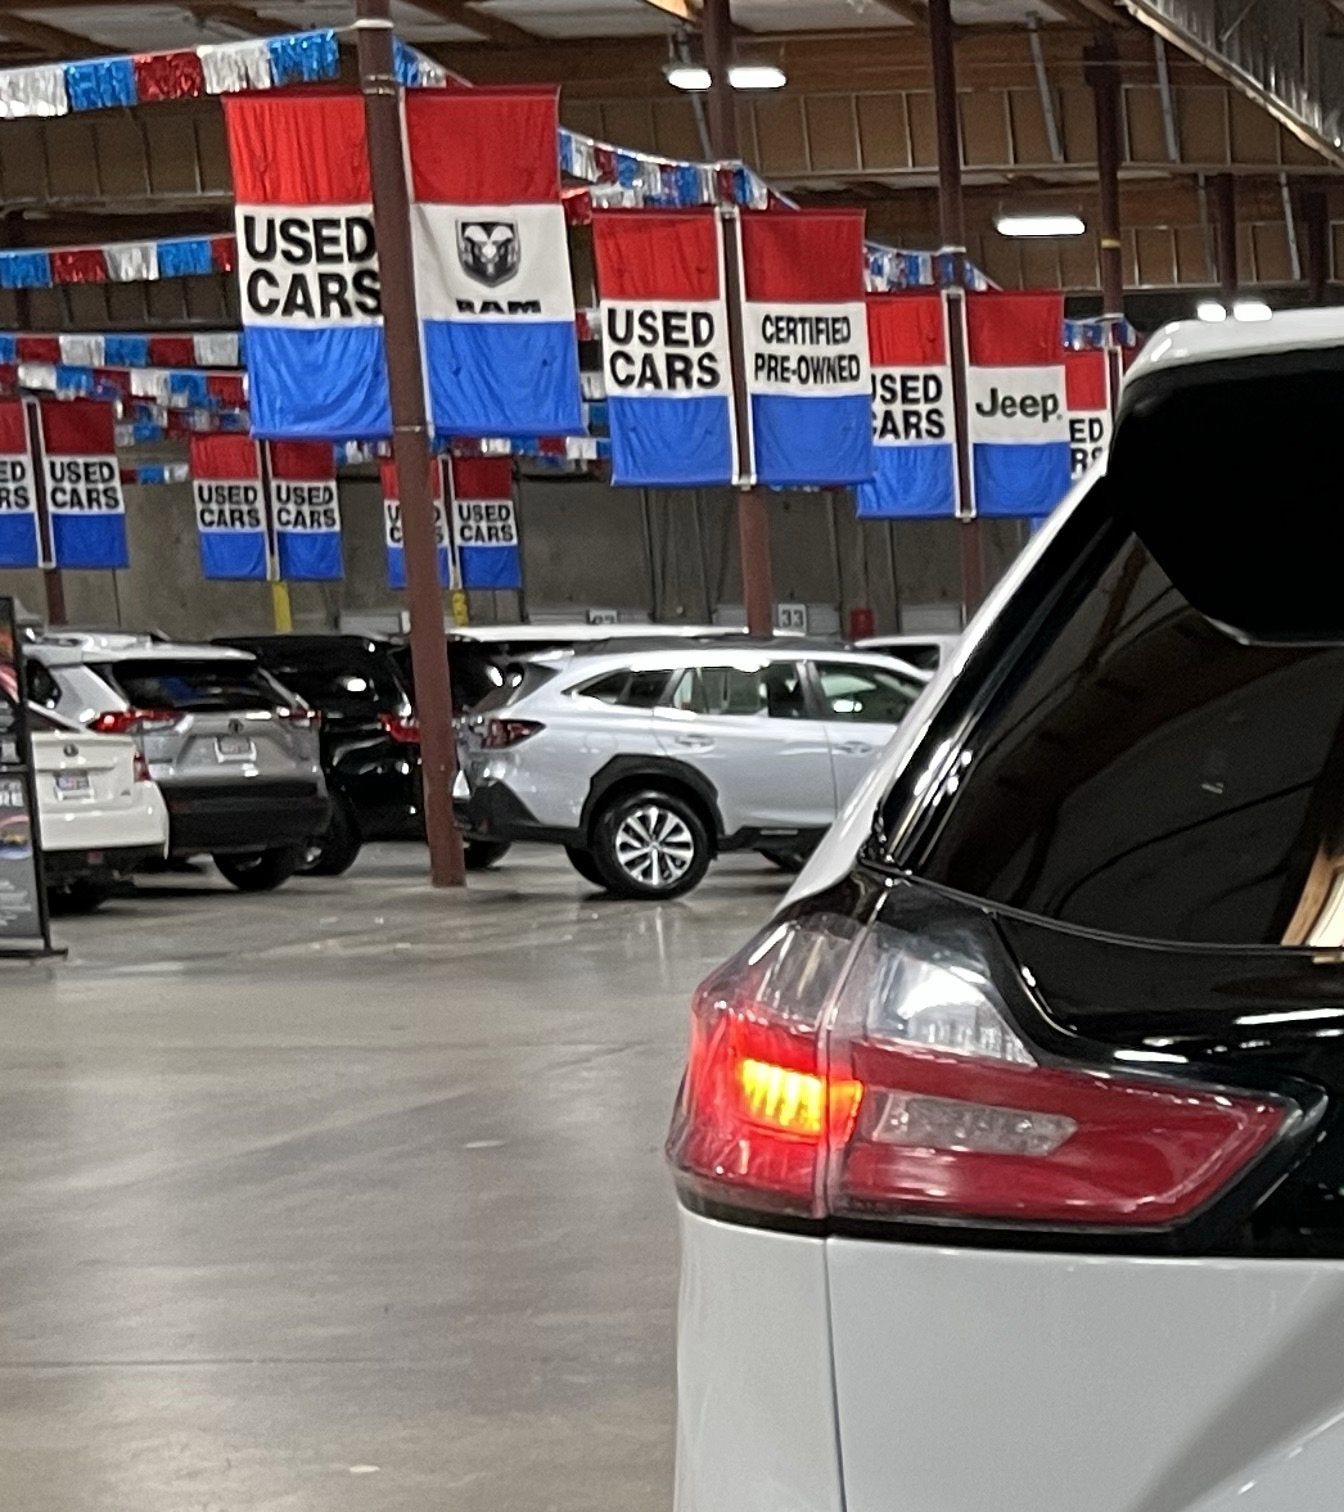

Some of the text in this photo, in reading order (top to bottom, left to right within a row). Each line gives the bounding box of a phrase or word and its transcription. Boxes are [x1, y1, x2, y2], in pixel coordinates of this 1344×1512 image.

[244, 215, 376, 265] USED
[247, 268, 382, 319] CARS
[455, 299, 541, 315] RAM
[607, 308, 715, 348] USED
[761, 314, 850, 346] CERTIFIED
[609, 350, 721, 390] CARS
[754, 352, 861, 385] PRE-OWNED
[976, 388, 1059, 423] Jeep
[872, 408, 945, 440] ARS
[50, 461, 115, 484] USED
[51, 487, 120, 511] CARS
[198, 484, 258, 506] USED
[276, 485, 334, 506] USED
[200, 508, 261, 528] CARS
[277, 507, 337, 529] CARS
[458, 503, 511, 523] USED
[460, 525, 514, 544] CARS
